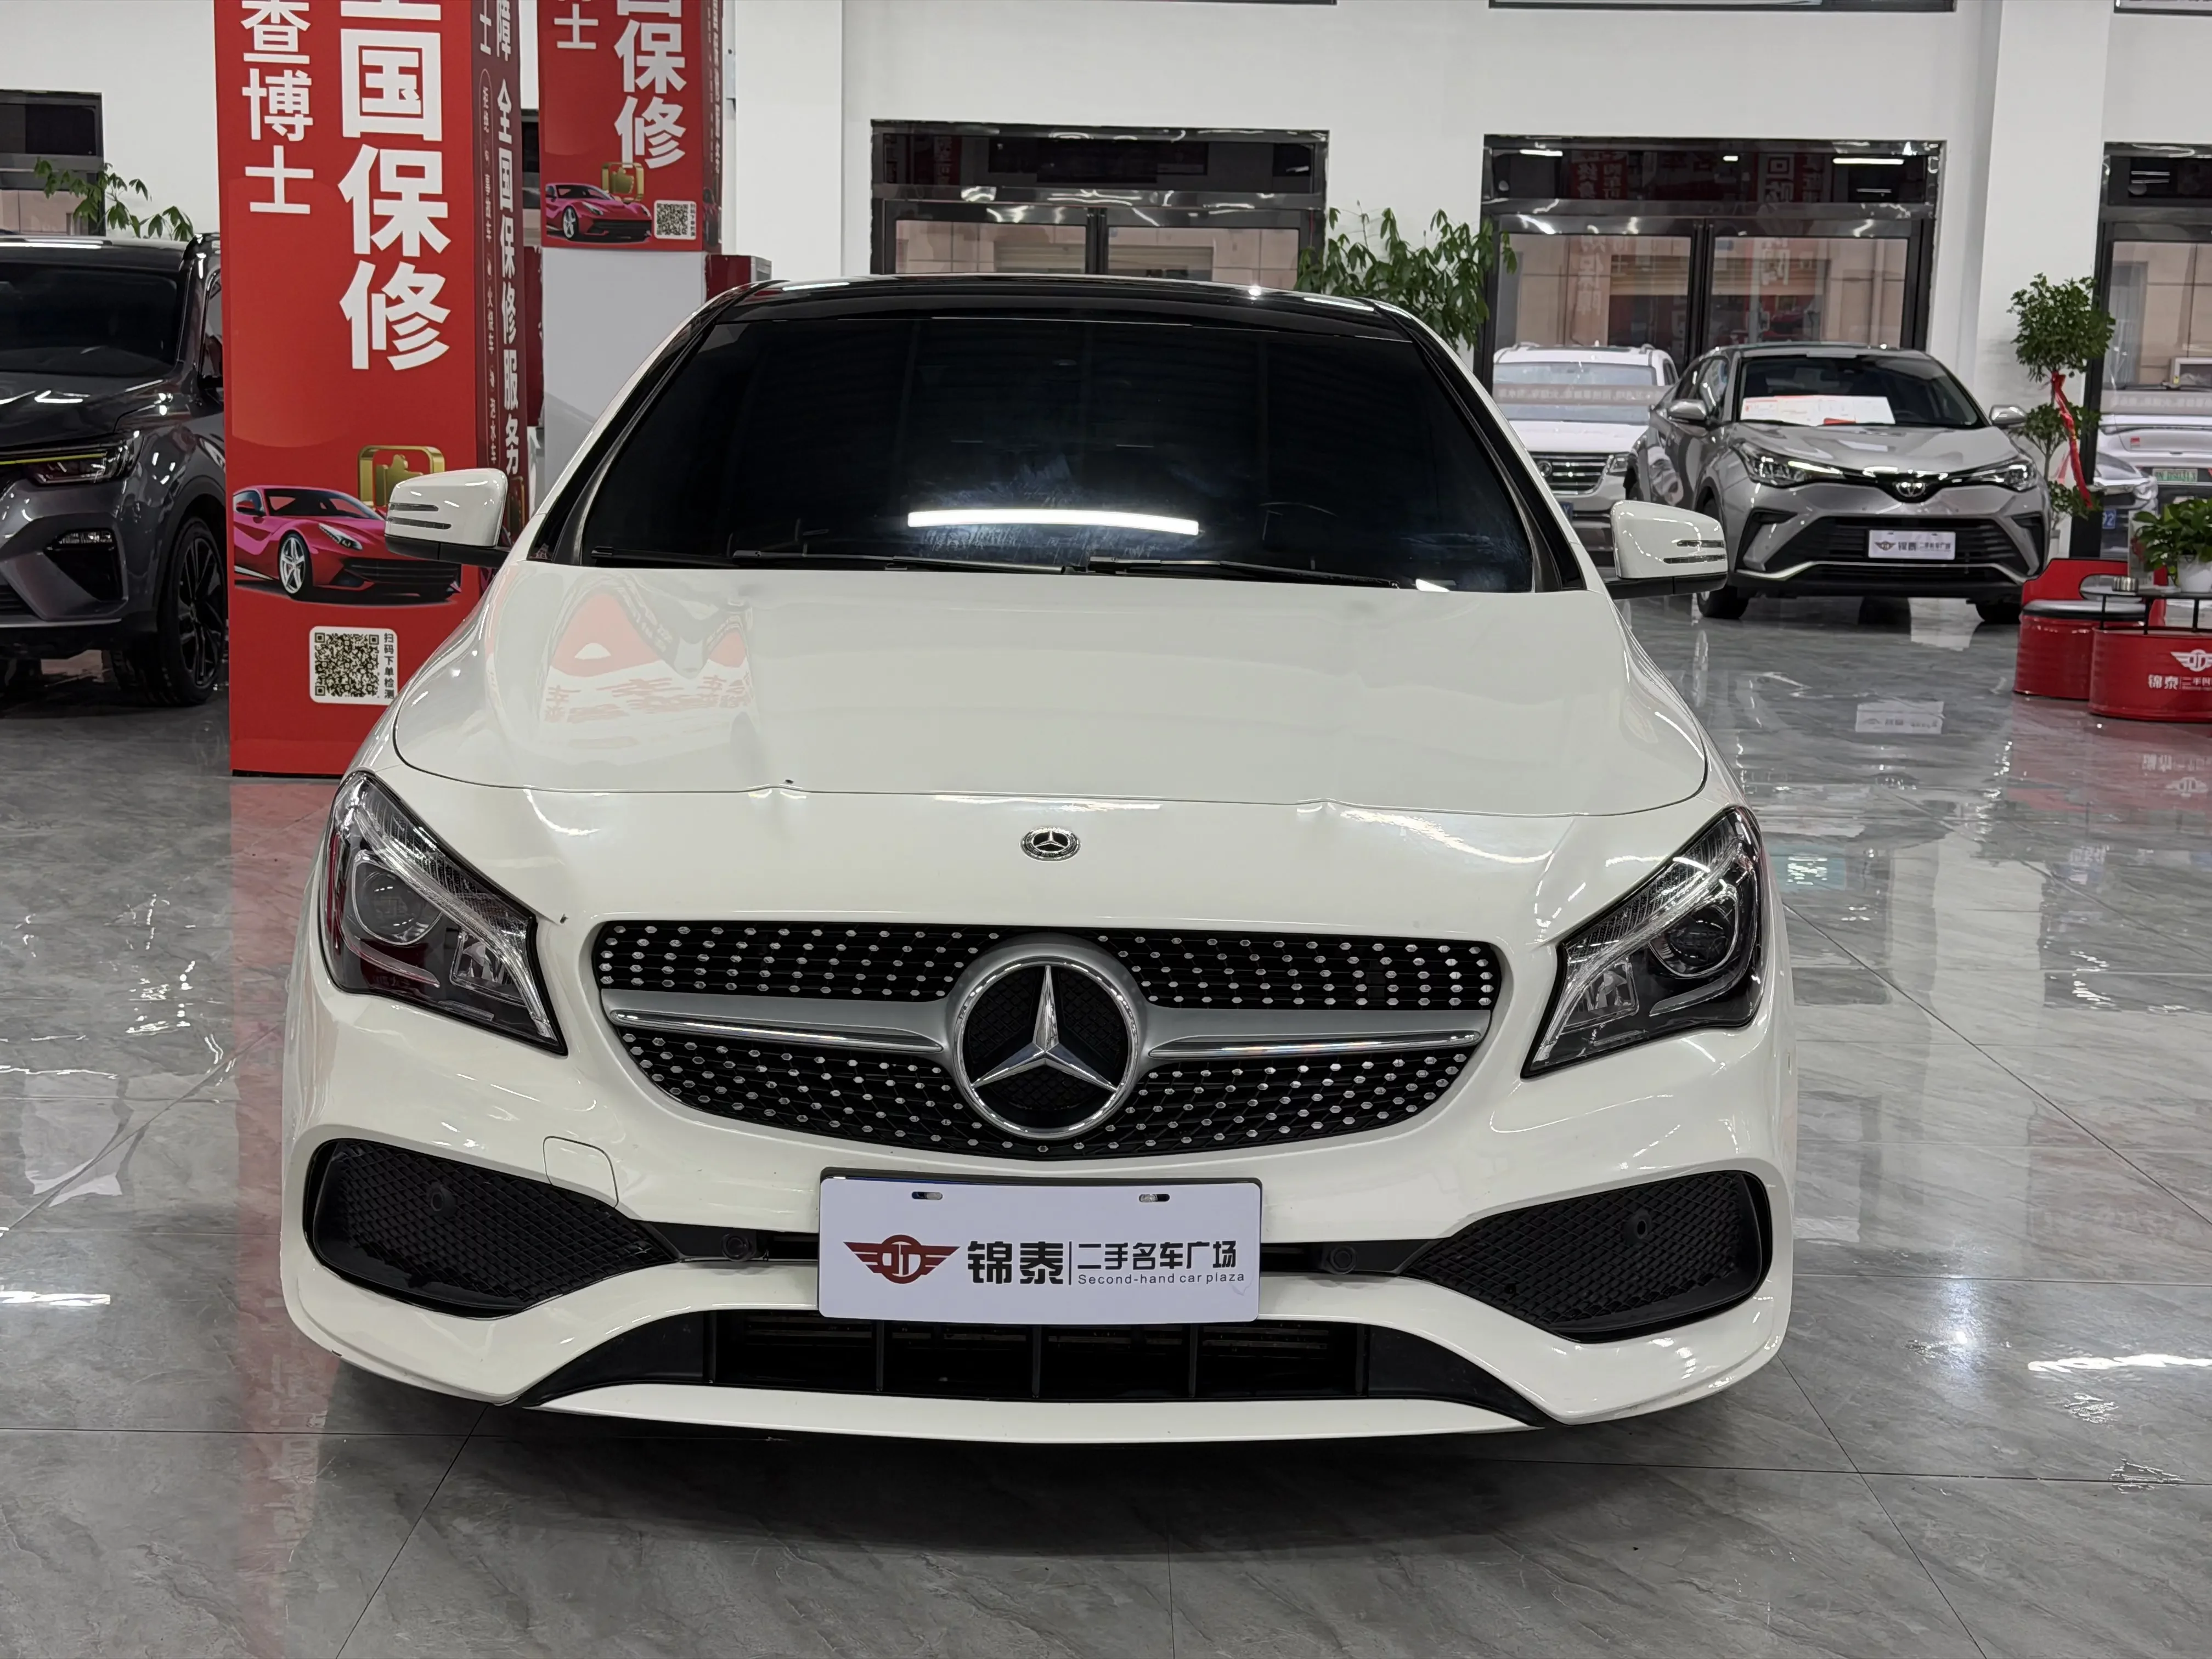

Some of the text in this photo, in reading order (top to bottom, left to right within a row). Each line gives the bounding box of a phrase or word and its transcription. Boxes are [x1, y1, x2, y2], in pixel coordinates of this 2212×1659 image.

[554, 0, 599, 49] 士
[241, 0, 314, 214] 查博士
[614, 0, 686, 169] 保修
[337, 0, 451, 370] 国保修
[384, 633, 394, 699] 扫码下单检测
[967, 1240, 1064, 1284] 锦泰
[1077, 1240, 1237, 1271] 二手名车广场
[1078, 1272, 1244, 1285] Second-hand car plaza
